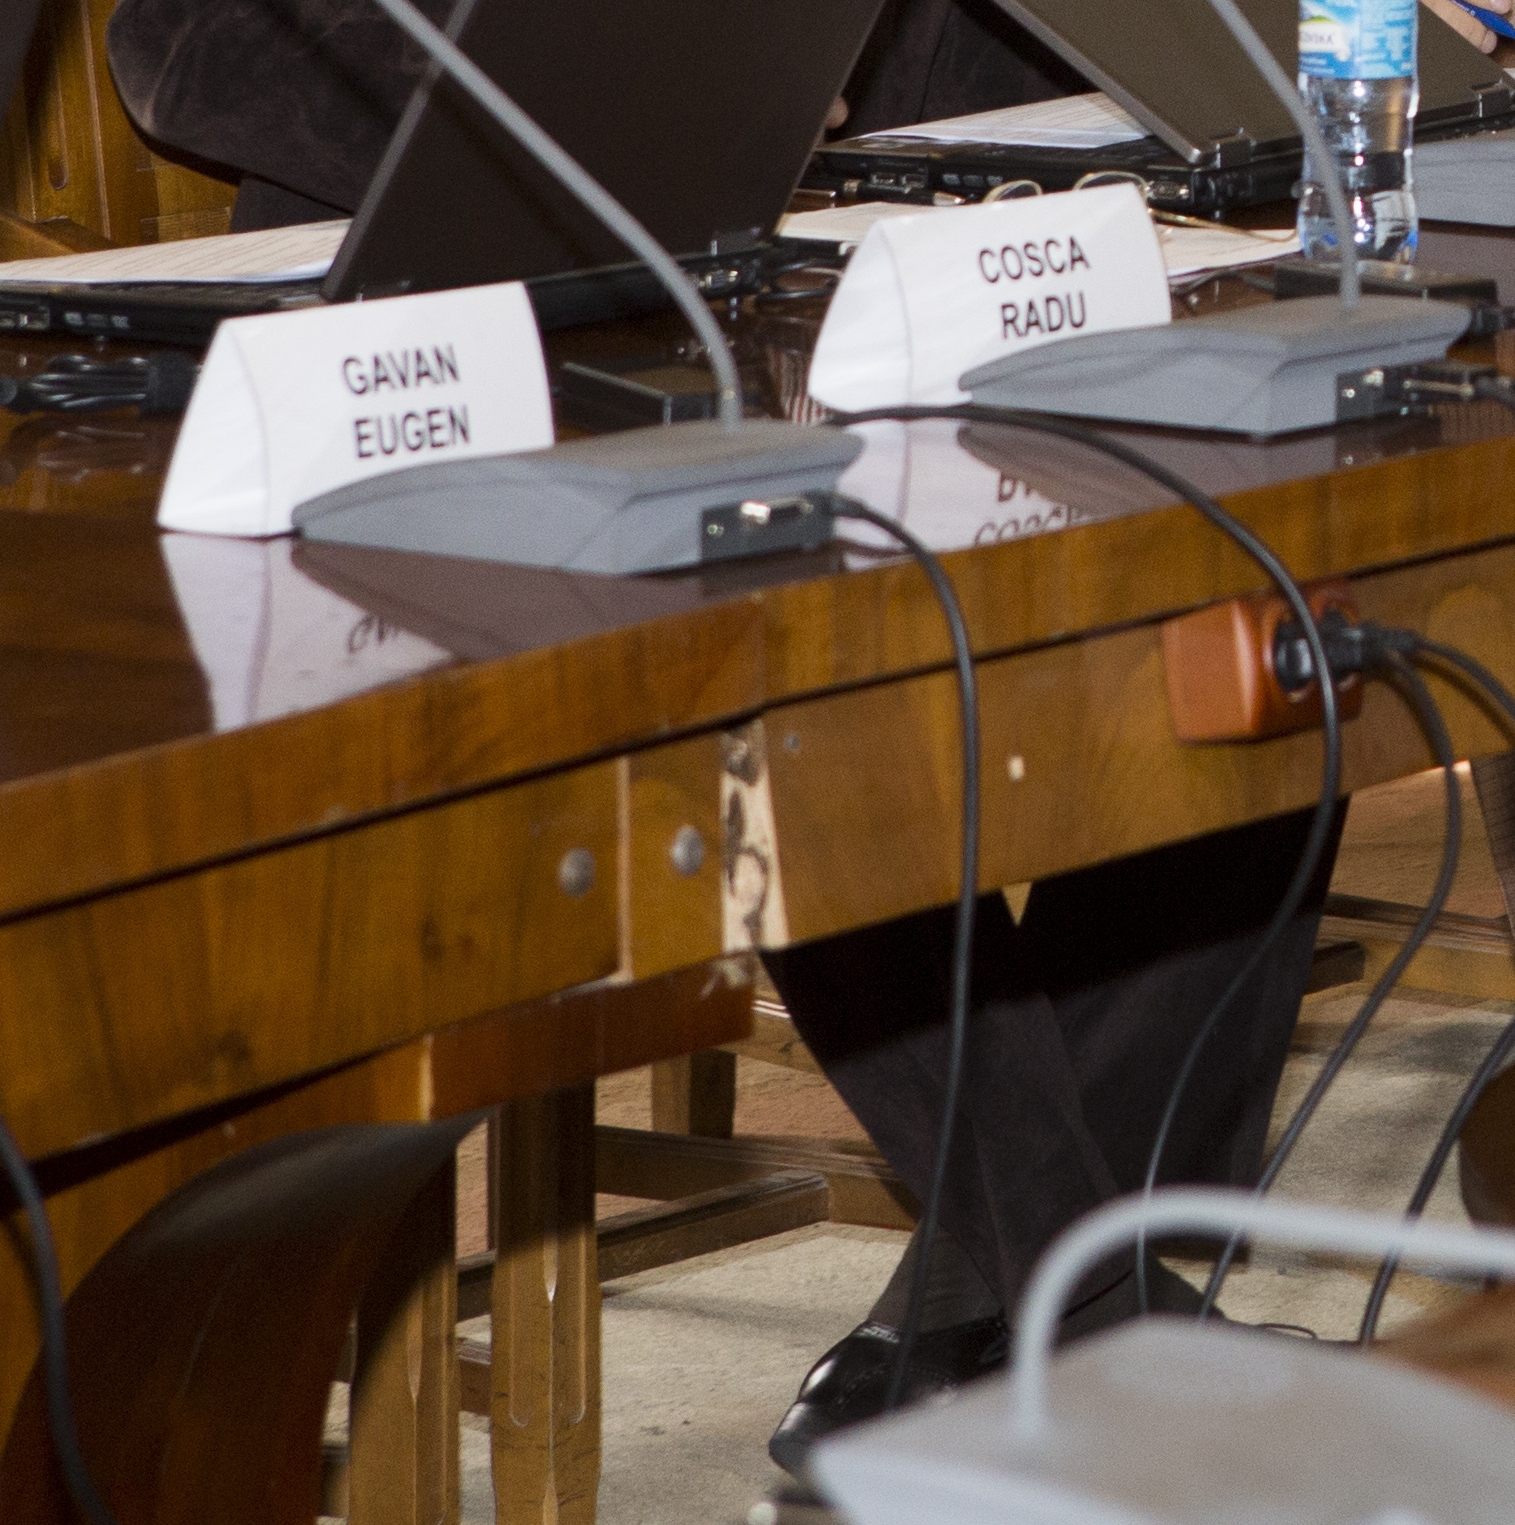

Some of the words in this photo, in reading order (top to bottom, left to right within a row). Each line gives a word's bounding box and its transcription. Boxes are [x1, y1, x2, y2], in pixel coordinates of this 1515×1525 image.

[978, 236, 1090, 284] COSCA
[1000, 292, 1088, 341] RADU
[342, 344, 460, 397] GAVAN
[354, 405, 471, 459] EUGEN
